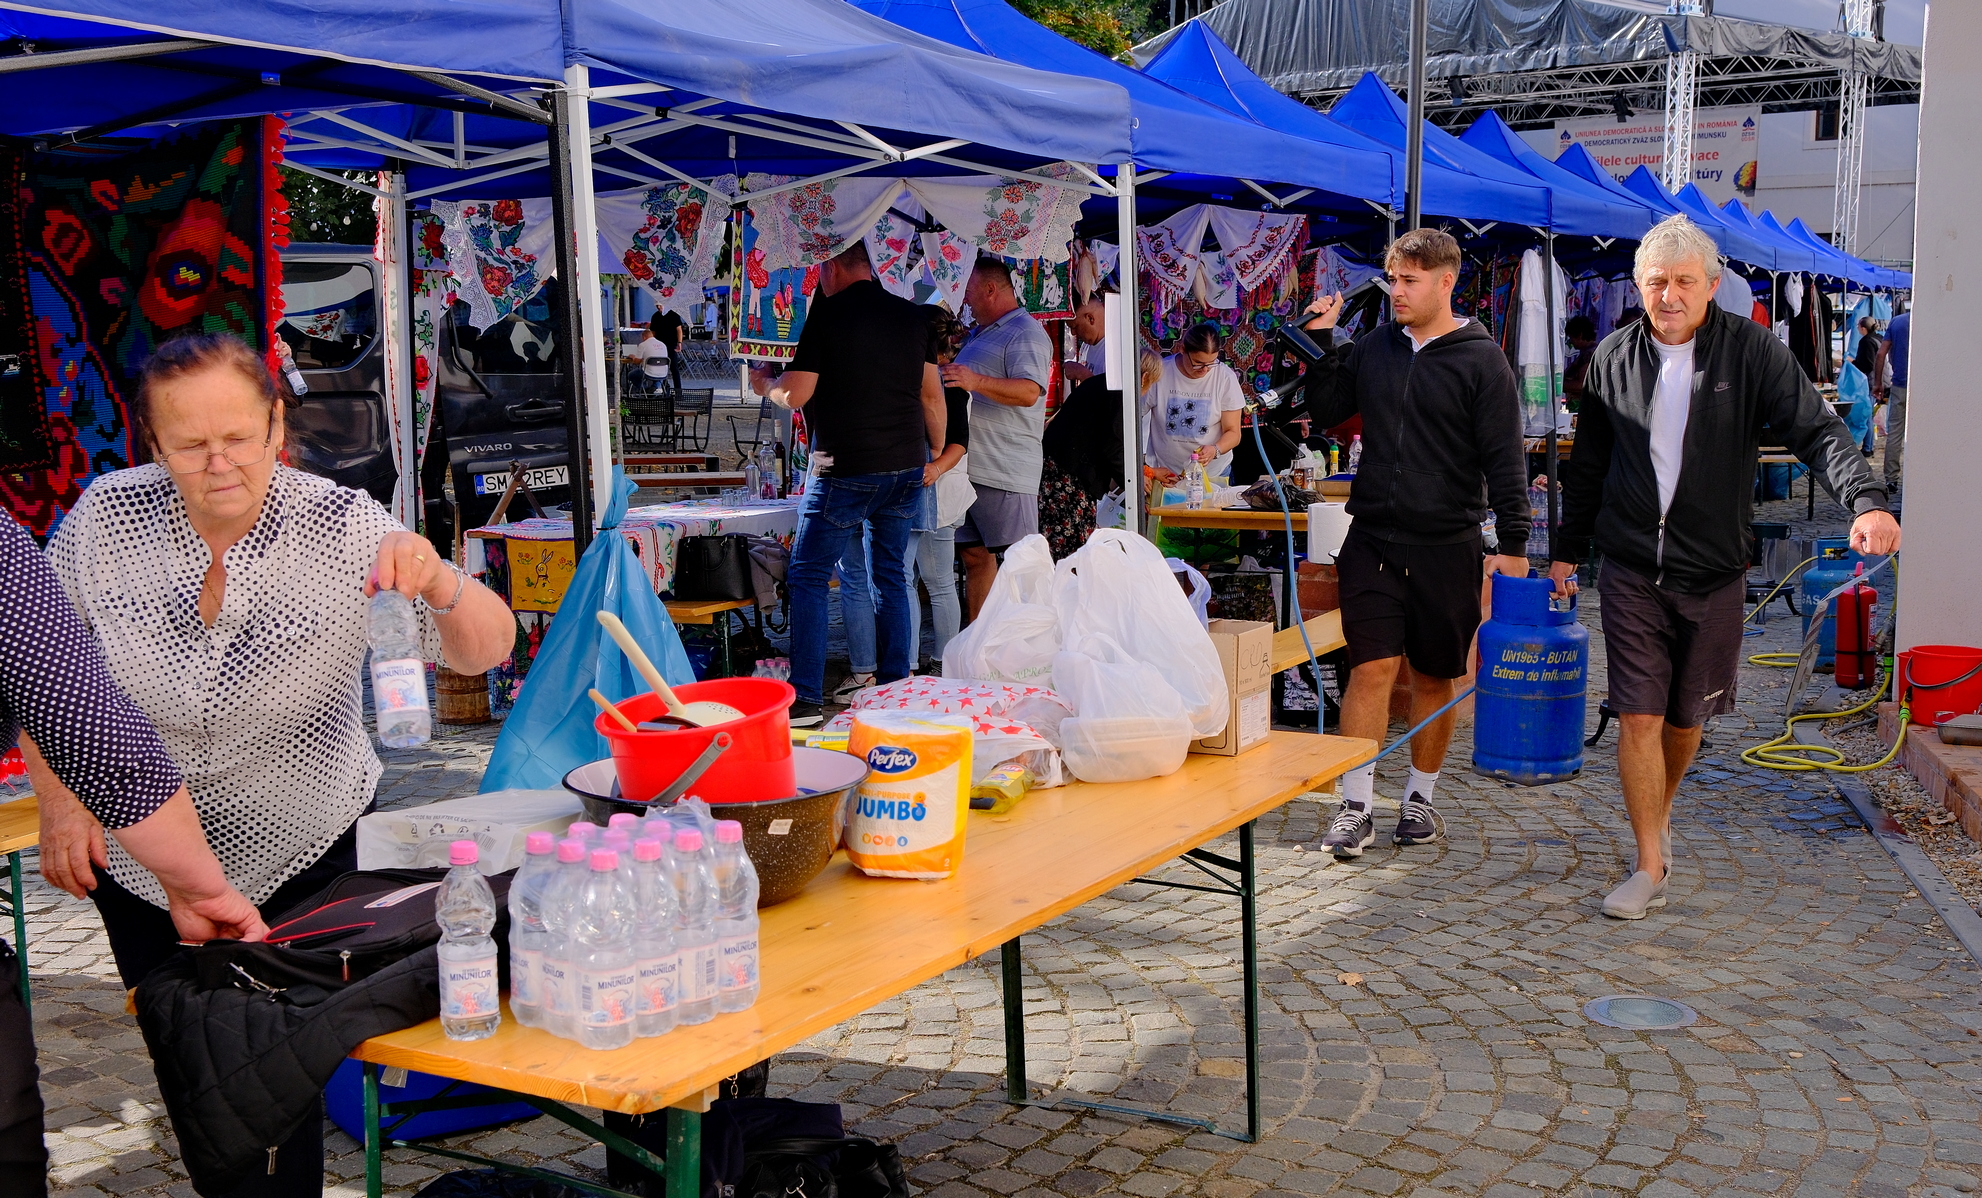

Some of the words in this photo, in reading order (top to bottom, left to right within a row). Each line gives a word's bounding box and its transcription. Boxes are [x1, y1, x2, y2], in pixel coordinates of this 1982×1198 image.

[1575, 129, 1602, 138] UNIUNEA
[1594, 154, 1621, 166] ilele
[464, 442, 513, 453] VIVARO
[1547, 650, 1578, 664] BUTAN
[376, 669, 415, 679] MINUNILOR
[1492, 664, 1524, 680] Extrem
[870, 749, 914, 769] Perfex
[856, 797, 926, 821] JUMBO
[944, 858, 950, 867] 2
[724, 940, 757, 955] MINUNILOR
[449, 969, 492, 982] MINUNILOR
[639, 963, 677, 978] MINUNILOR
[597, 975, 635, 990] MINUNILOR
